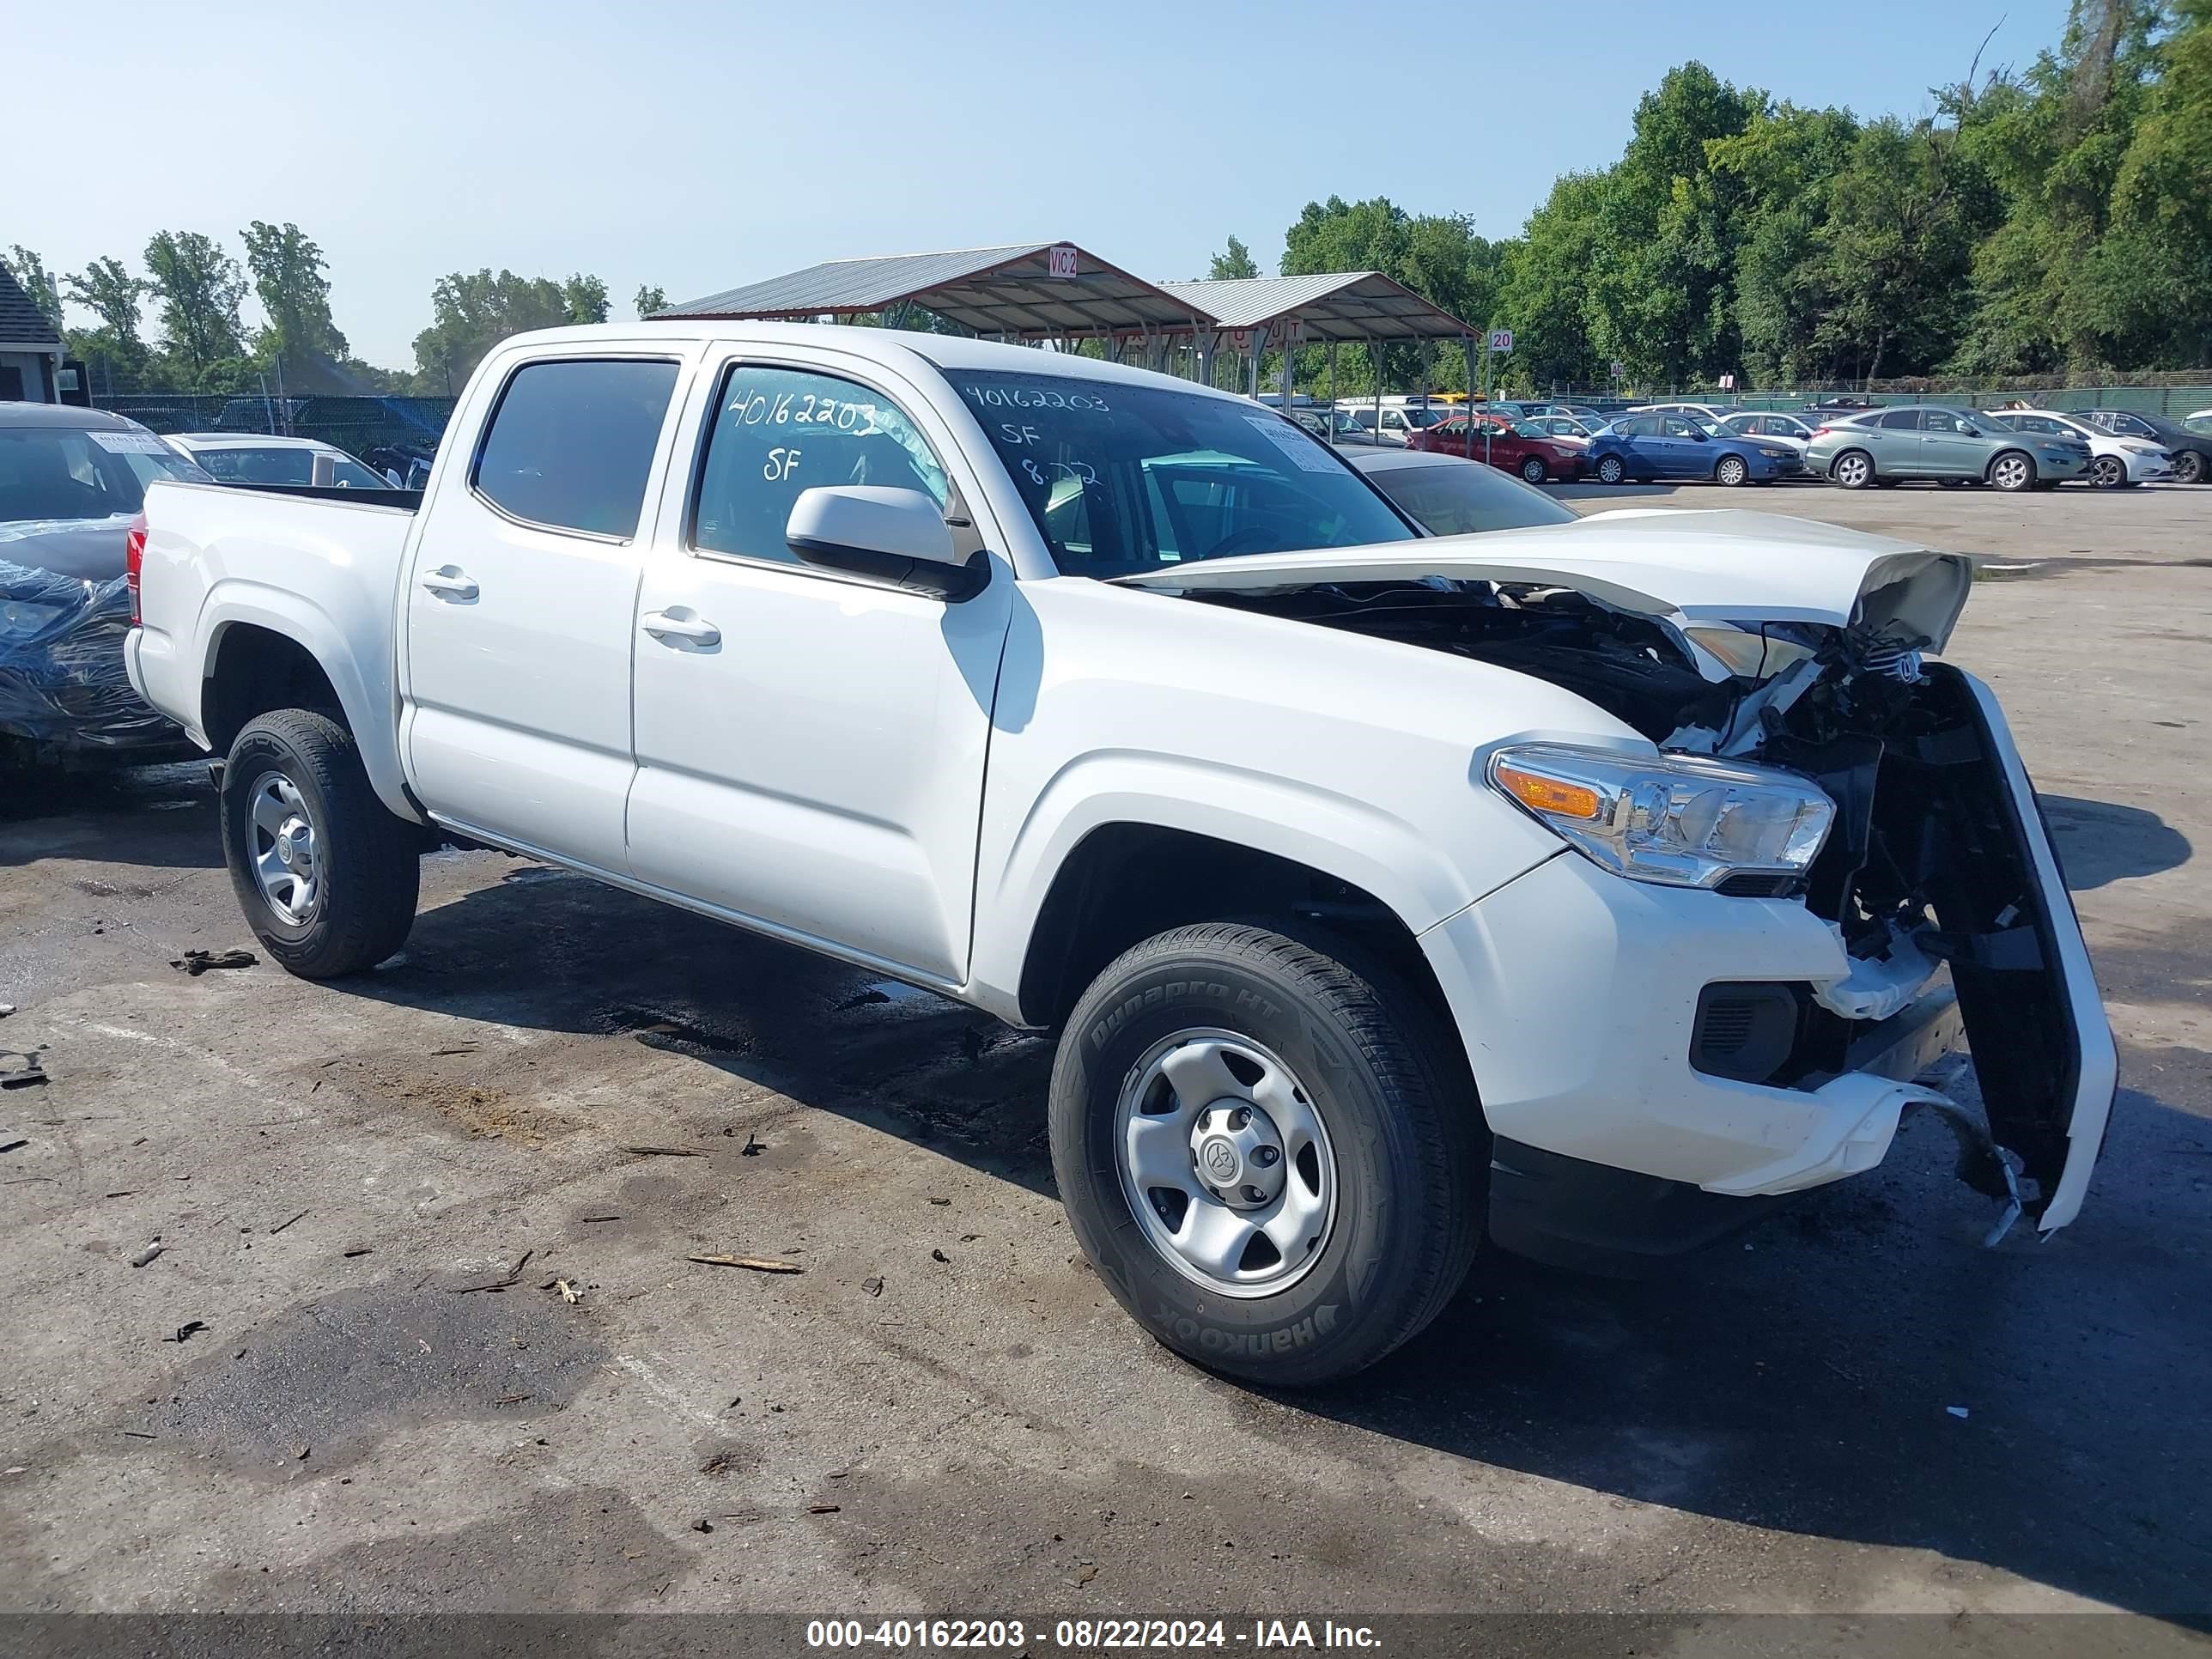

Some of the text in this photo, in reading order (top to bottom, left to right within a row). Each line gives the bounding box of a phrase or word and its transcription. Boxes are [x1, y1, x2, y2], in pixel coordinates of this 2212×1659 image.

[1050, 250, 1077, 274] VIC 2
[1493, 333, 1510, 348] 20
[966, 386, 1110, 412] 40162203
[728, 389, 877, 436] 40162203
[1001, 423, 1041, 446] SF
[763, 447, 803, 481] SF
